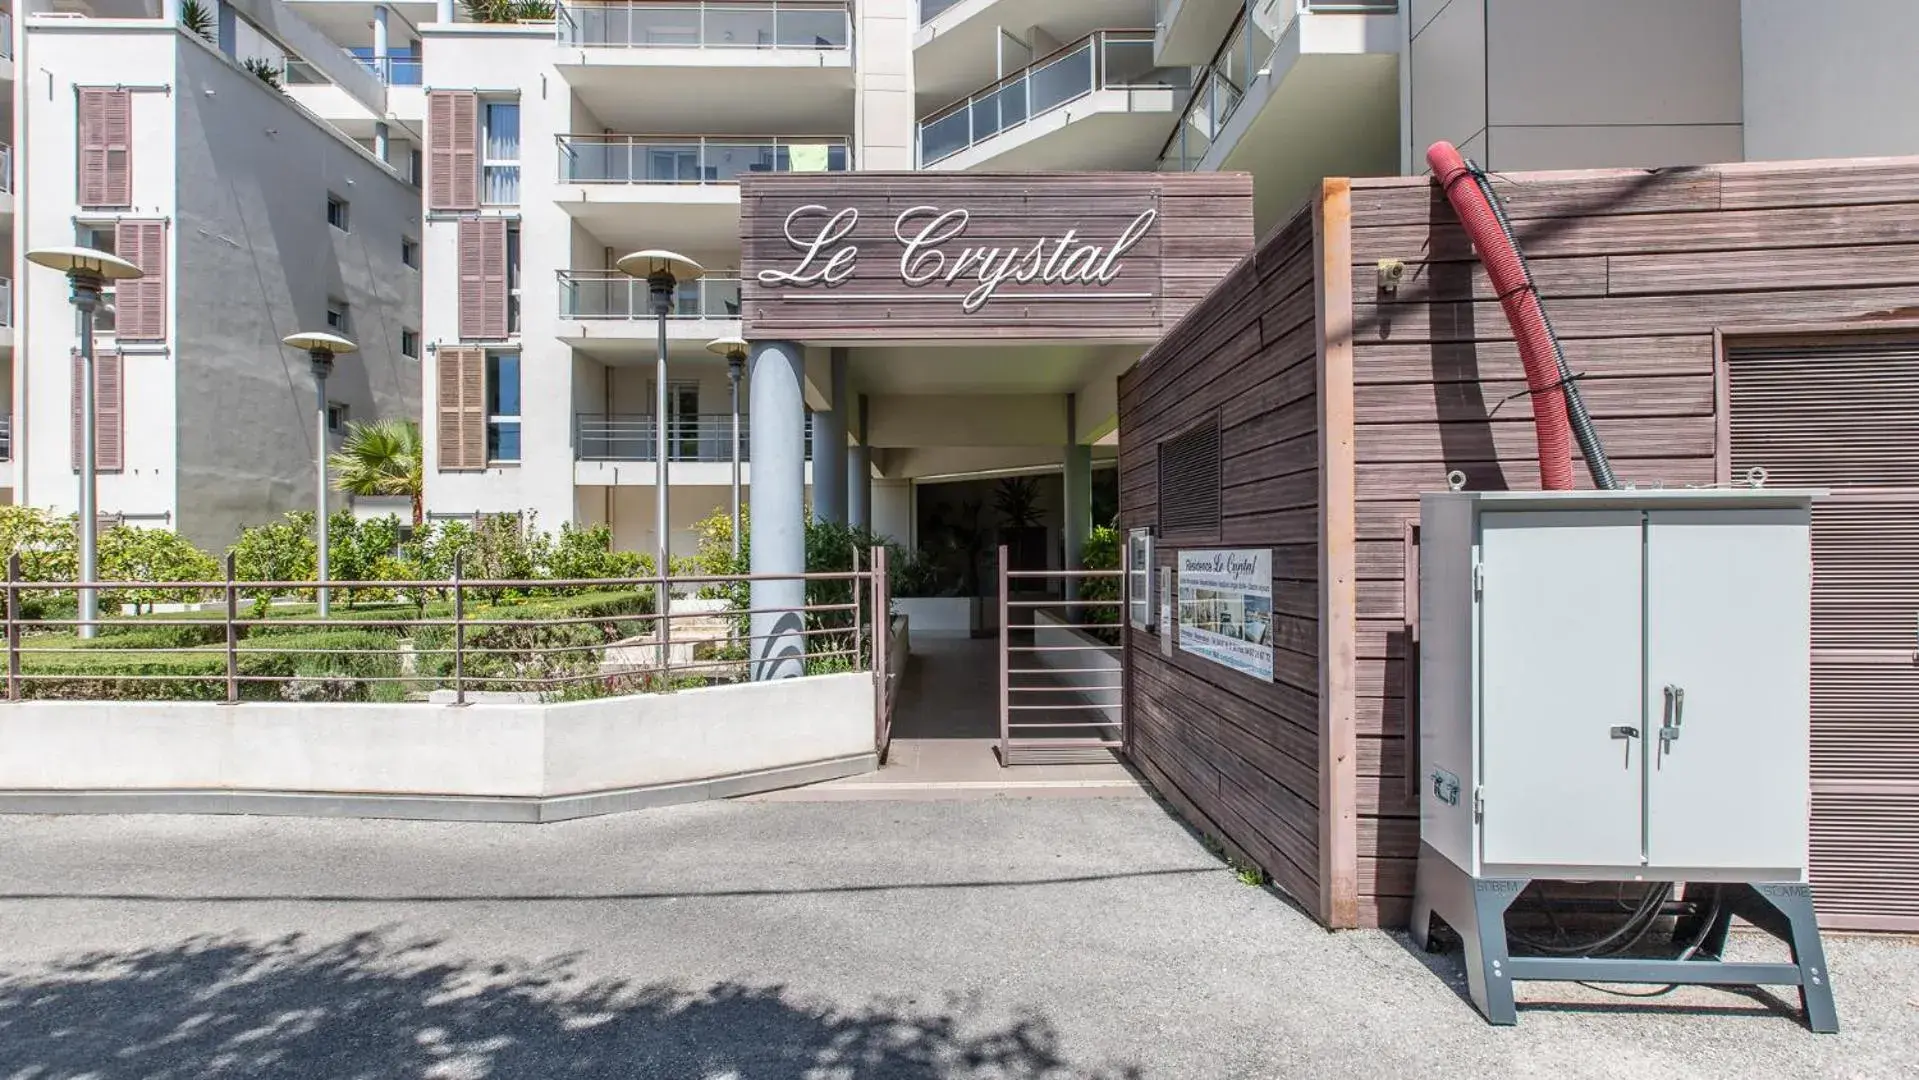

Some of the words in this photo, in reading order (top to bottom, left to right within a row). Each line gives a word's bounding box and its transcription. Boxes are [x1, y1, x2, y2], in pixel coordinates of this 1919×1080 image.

[758, 204, 859, 284] Le
[894, 205, 1156, 310] Crystal
[1213, 552, 1223, 573] Le
[1227, 552, 1257, 580] Crystal
